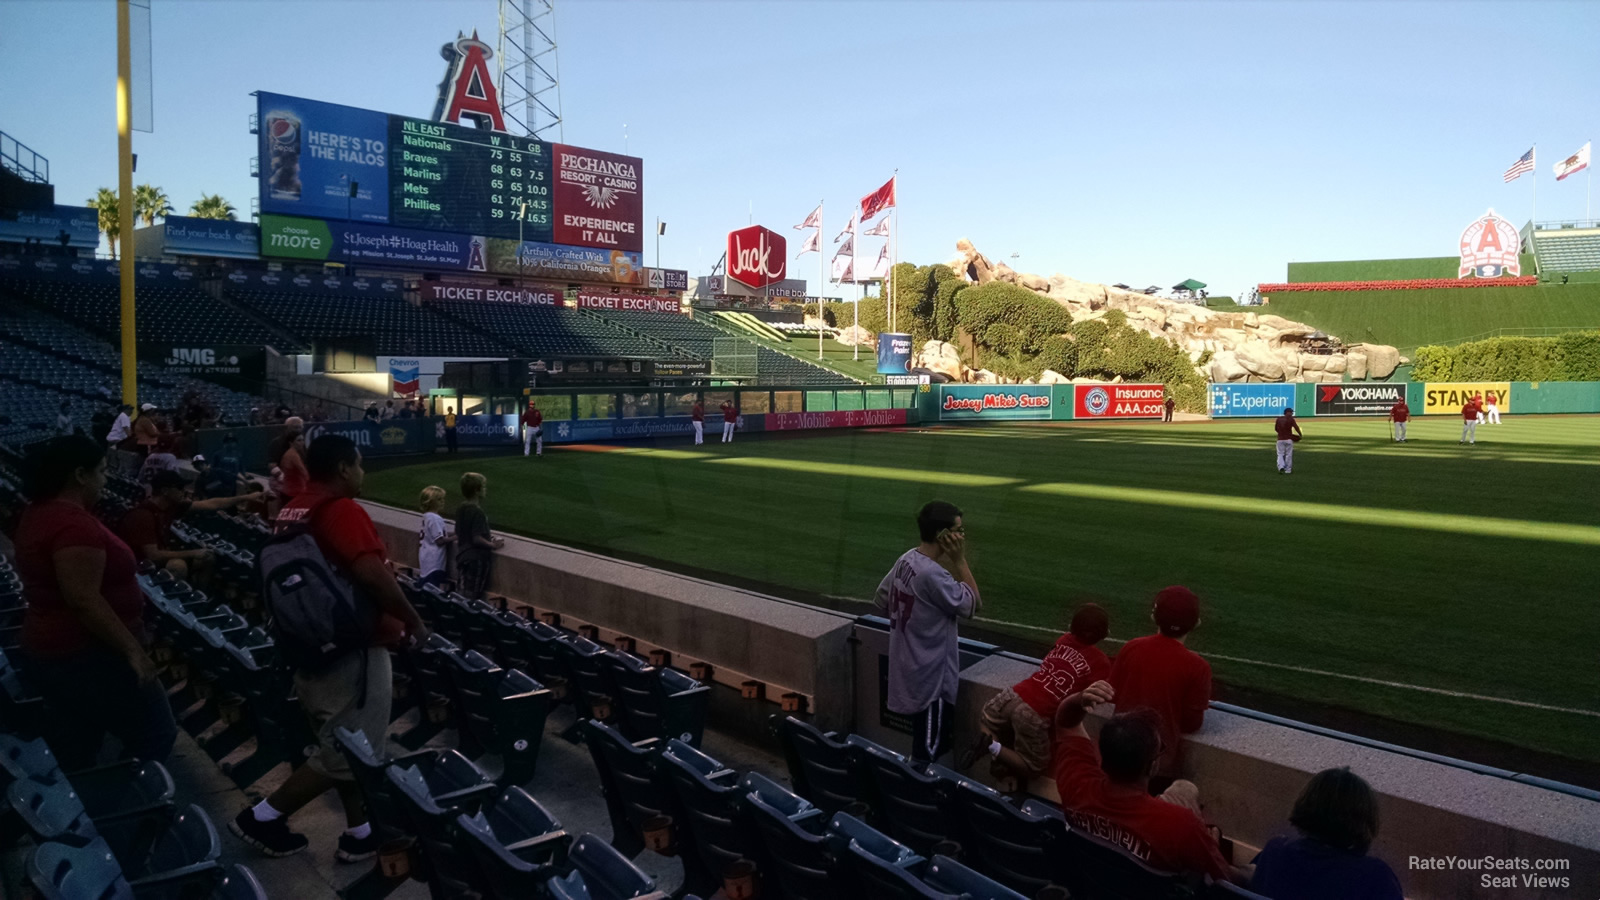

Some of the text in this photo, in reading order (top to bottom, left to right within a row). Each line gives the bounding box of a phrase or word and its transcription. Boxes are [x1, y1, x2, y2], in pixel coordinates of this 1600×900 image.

[403, 121, 446, 136] NL EAST
[308, 130, 385, 153] HERE'S TO
[403, 135, 452, 151] Nationals
[490, 136, 500, 146] W
[511, 140, 517, 149] L
[490, 149, 503, 159] 75
[528, 143, 541, 153] GB
[308, 145, 385, 167] THE HALOS
[403, 151, 438, 164] Braves
[509, 153, 522, 162] 55
[490, 165, 503, 174] 68
[510, 168, 522, 177] 63
[560, 153, 637, 179] PECHANGA
[403, 167, 441, 181] Marlins
[529, 170, 544, 180] 7.5
[560, 170, 637, 190] RESORT CASINO
[403, 182, 429, 195] Mets
[491, 180, 503, 189] 65
[510, 182, 522, 192] 65
[527, 185, 547, 195] 10.0
[404, 198, 441, 211] Phillies
[491, 194, 503, 204] 61
[510, 196, 522, 206] 70
[528, 200, 547, 210] 14.5
[491, 209, 503, 218] 59
[510, 211, 521, 221] 72
[527, 213, 547, 224] 16.5
[563, 214, 635, 233] EXPERIENCE
[166, 225, 231, 240] Find your beach
[282, 226, 309, 235] choose
[582, 230, 618, 244] IT ALL
[271, 233, 321, 249] more
[401, 237, 427, 253] Hoag
[428, 240, 459, 253] Health
[343, 249, 360, 257] Hag
[523, 246, 604, 262] Artfully Crafted With
[732, 232, 784, 278] Jack
[516, 257, 611, 274] 100% California Oranges
[433, 286, 555, 305] TICKET EXCHANGE
[776, 287, 790, 297] the
[791, 288, 807, 298] box
[579, 295, 678, 312] TICKET EXCHANGE
[164, 348, 215, 366] JMG
[389, 358, 420, 366] Chevron
[1340, 388, 1399, 400] YOKOHAMA
[1427, 390, 1507, 406] STANEY
[944, 396, 982, 413] Jersey
[983, 394, 1018, 409] Mike's
[1232, 393, 1287, 411] Experian
[455, 423, 515, 437] oolsculpting
[615, 421, 693, 437] socalbodyinstitute.co
